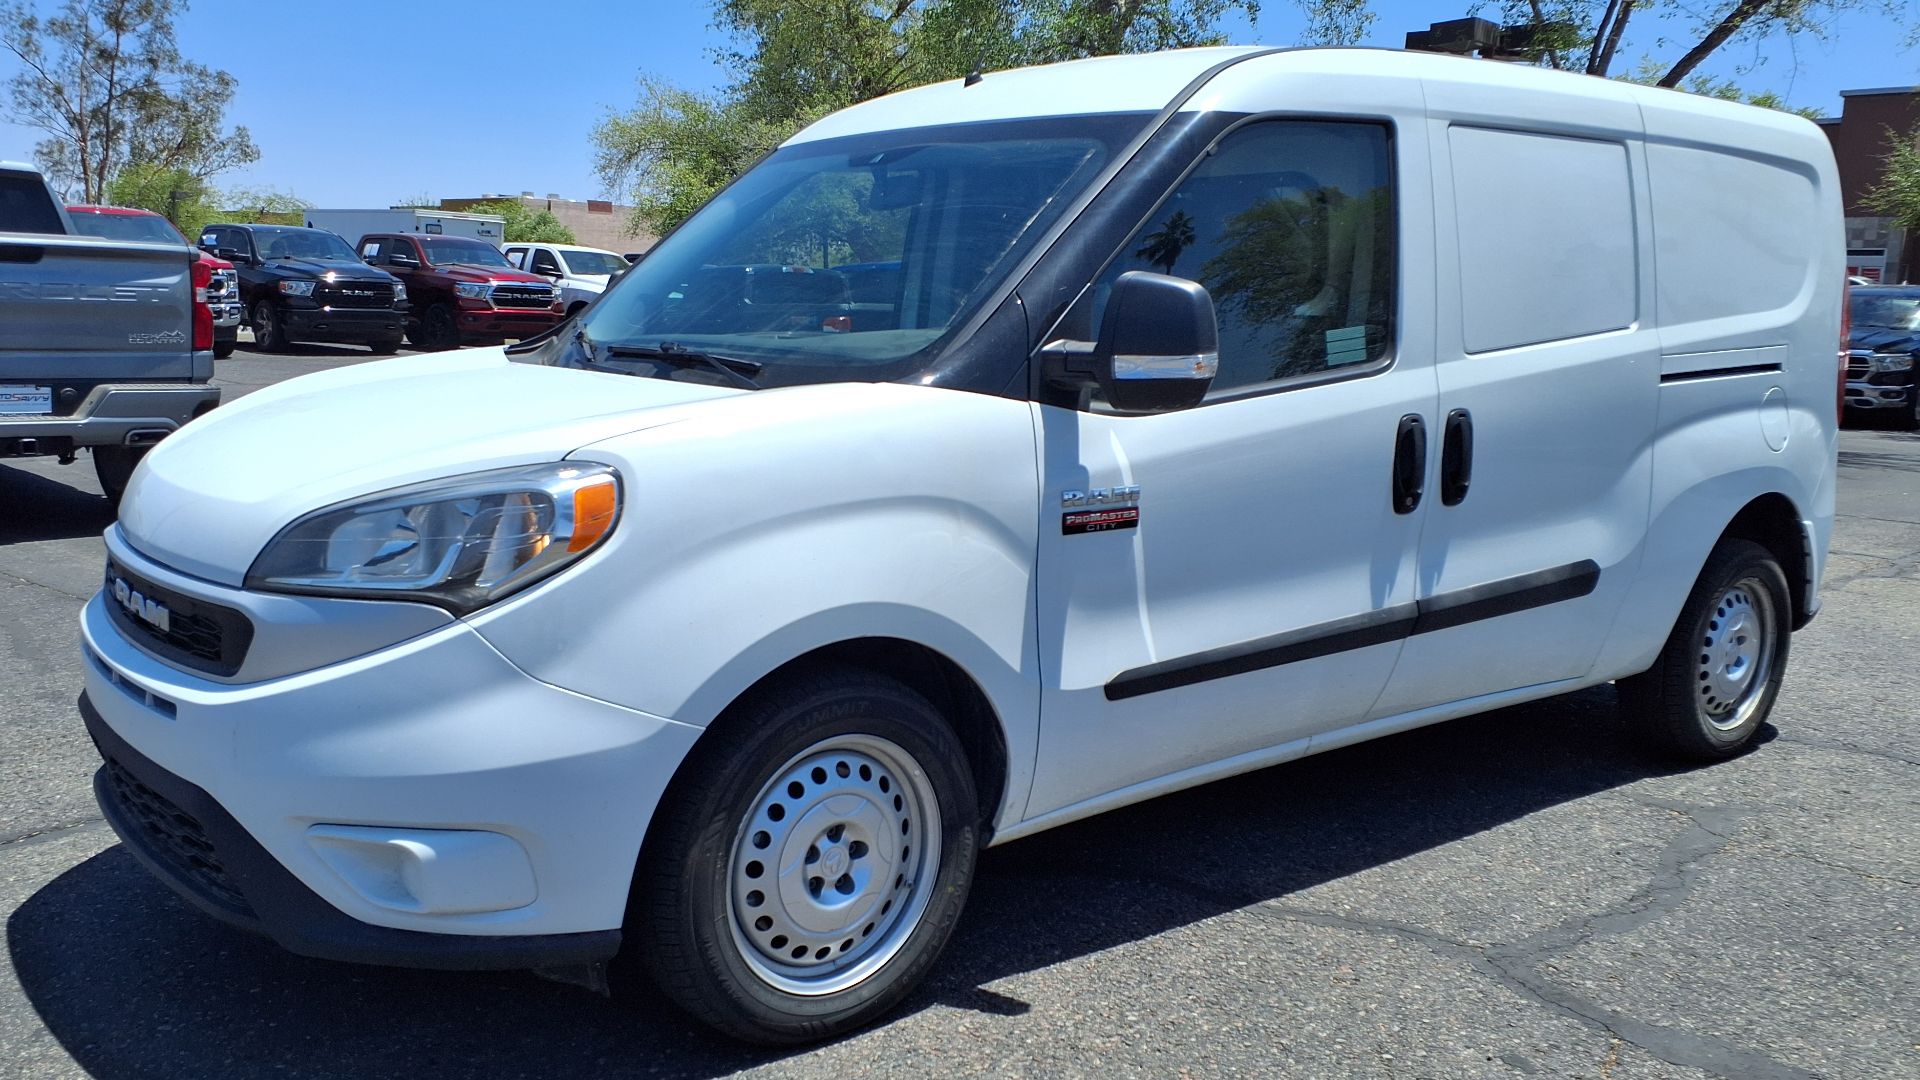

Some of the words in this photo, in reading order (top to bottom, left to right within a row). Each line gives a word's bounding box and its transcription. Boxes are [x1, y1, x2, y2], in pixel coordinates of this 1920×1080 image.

[1061, 486, 1140, 507] RAM
[1086, 522, 1117, 531] CITY
[115, 578, 169, 631] RAM
